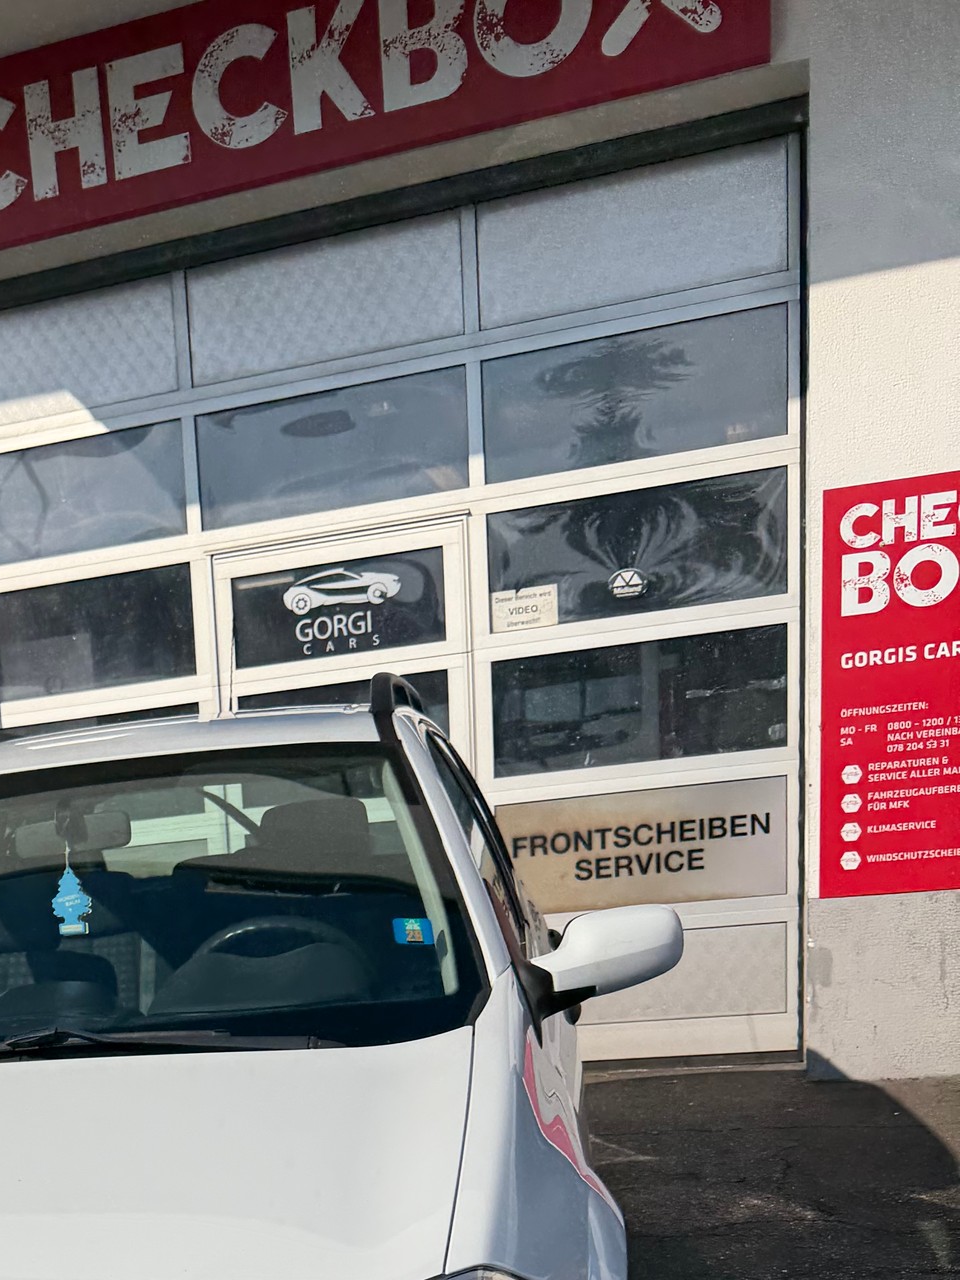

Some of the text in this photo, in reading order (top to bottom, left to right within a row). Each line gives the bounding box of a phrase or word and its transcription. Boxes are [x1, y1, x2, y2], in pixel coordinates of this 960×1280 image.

[840, 489, 960, 549] CHE
[508, 604, 539, 616] VIDEO
[295, 610, 372, 642] GORGI
[302, 634, 380, 655] CARS
[840, 645, 917, 669] GORGIS
[840, 726, 856, 735] MO
[864, 724, 878, 733] FR
[887, 721, 912, 731] 0800
[922, 717, 944, 727] 1200
[840, 737, 853, 746] SA
[887, 732, 913, 742] NACH
[886, 744, 904, 753] 078
[906, 742, 924, 751] 204
[939, 739, 950, 748] 31
[868, 756, 949, 771] REPARATUREN &
[868, 771, 907, 782] SERVICE
[909, 767, 940, 778] ALLER
[867, 800, 910, 811] FÜR MFK
[867, 820, 937, 834] KLIMASERVICE
[511, 812, 771, 859] FRONTSCHEIBEN
[574, 848, 705, 881] SERVICE
